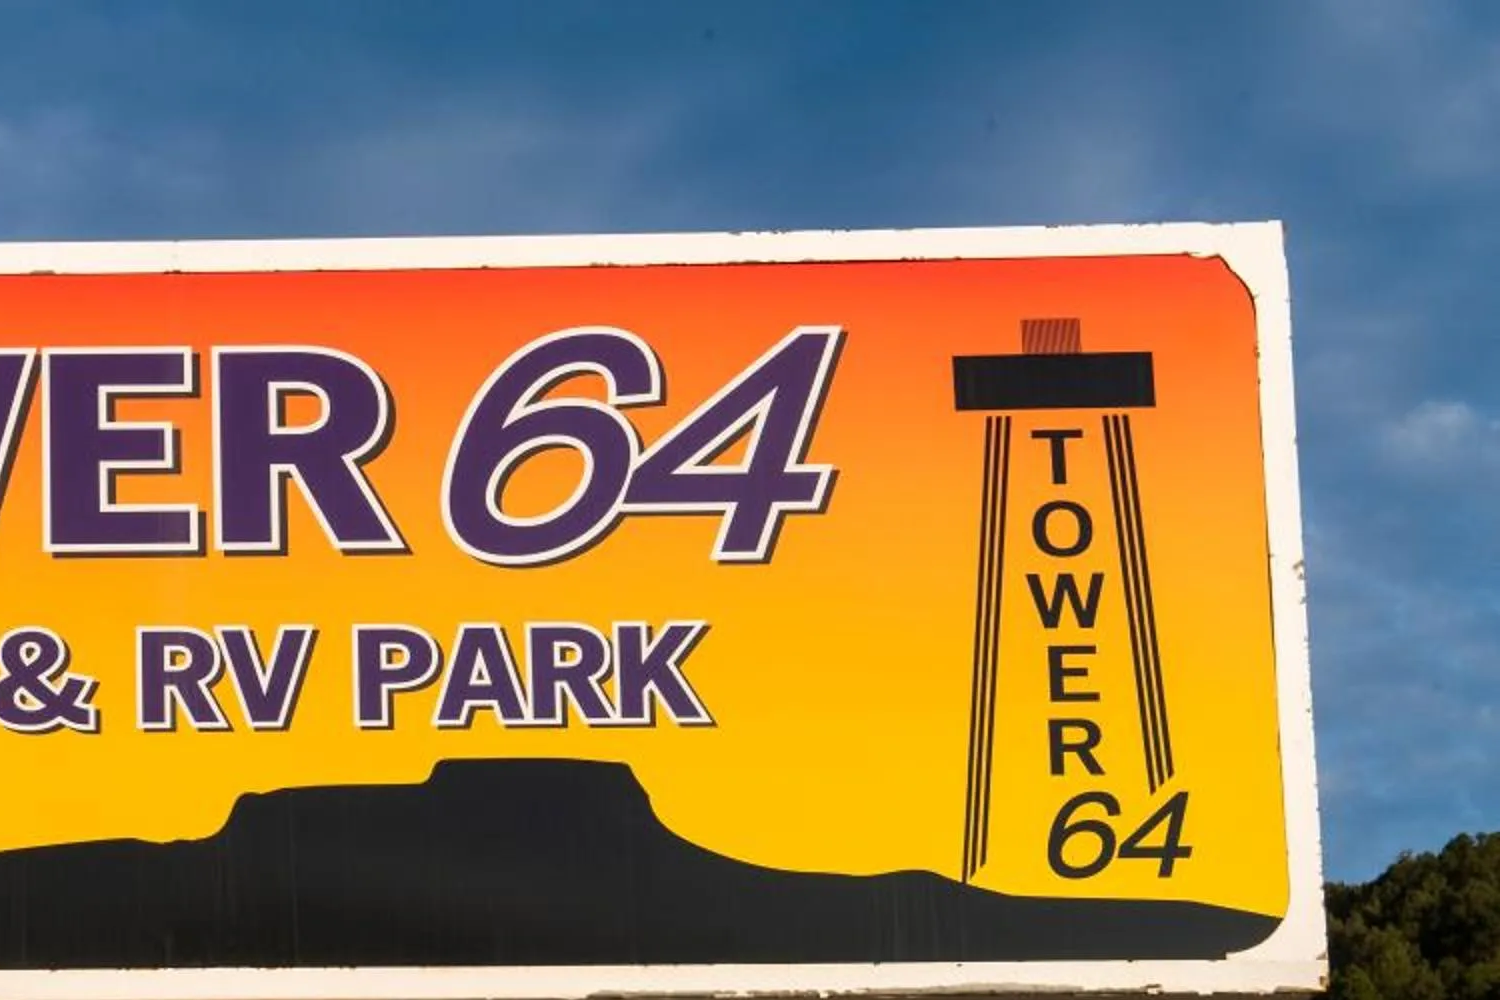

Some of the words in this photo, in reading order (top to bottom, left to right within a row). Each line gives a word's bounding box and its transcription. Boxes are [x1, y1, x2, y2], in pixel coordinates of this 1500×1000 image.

[441, 325, 847, 566] 64
[135, 624, 320, 731] RV
[351, 621, 717, 729] PARK
[1026, 428, 1105, 776] TOWER
[1046, 790, 1193, 879] 64
